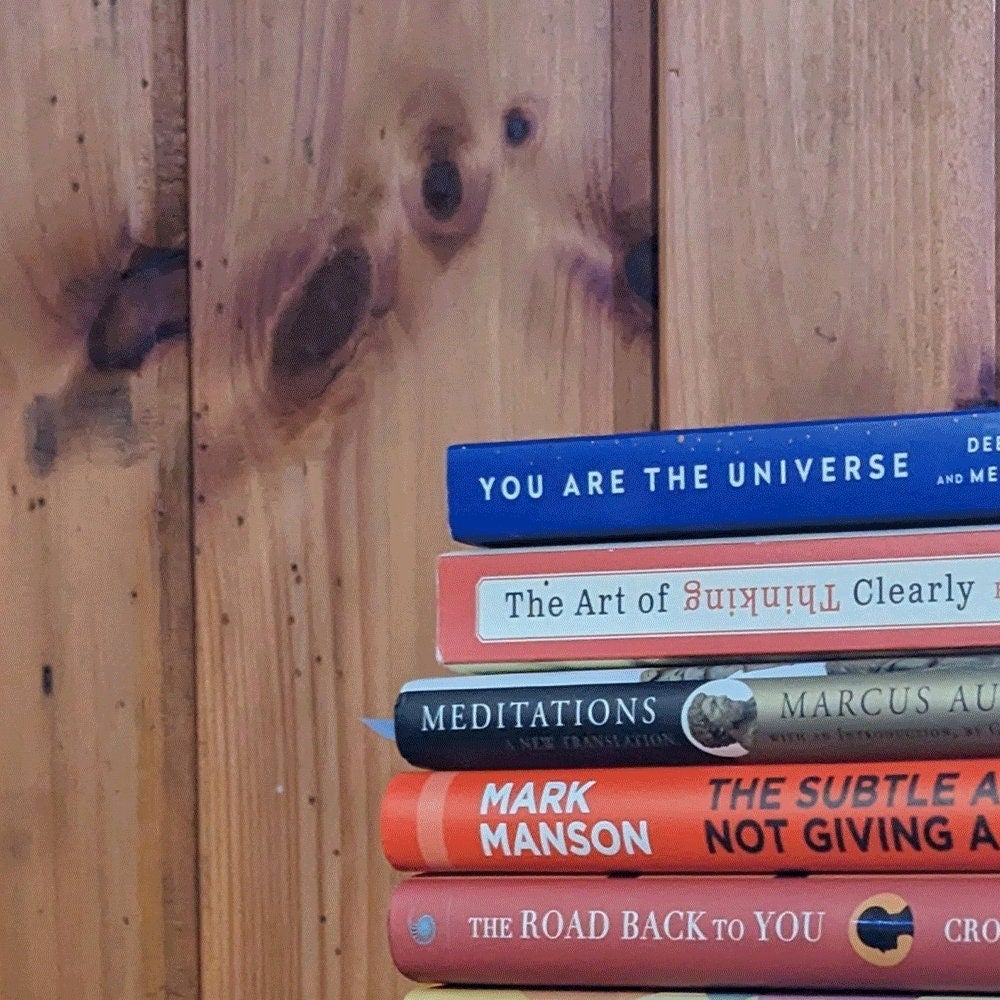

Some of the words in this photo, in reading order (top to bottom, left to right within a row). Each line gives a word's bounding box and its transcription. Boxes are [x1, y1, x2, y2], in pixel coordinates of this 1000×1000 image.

[479, 474, 544, 500] YOU
[563, 469, 625, 497] ARE
[644, 465, 708, 492] THE
[729, 452, 910, 488] UNIVERSE
[936, 474, 963, 485] AND
[505, 590, 564, 619] The
[575, 587, 626, 616] Art
[638, 583, 670, 614] of
[684, 581, 841, 617] Thinking
[854, 573, 975, 610] Clearly
[421, 696, 657, 732] MEDITATIONS
[781, 687, 930, 719] MARCUS
[563, 733, 676, 748] TRANSLATION
[479, 780, 597, 815] MARK
[709, 776, 786, 811] THE
[795, 771, 961, 808] SUBTLE
[479, 820, 652, 856] MANSON
[705, 819, 791, 854] NOT
[803, 815, 954, 853] GIVING
[969, 815, 1000, 850] A
[469, 917, 512, 939] THE
[519, 910, 610, 940] ROAD
[620, 912, 706, 941] BACK
[748, 911, 826, 943] YOU
